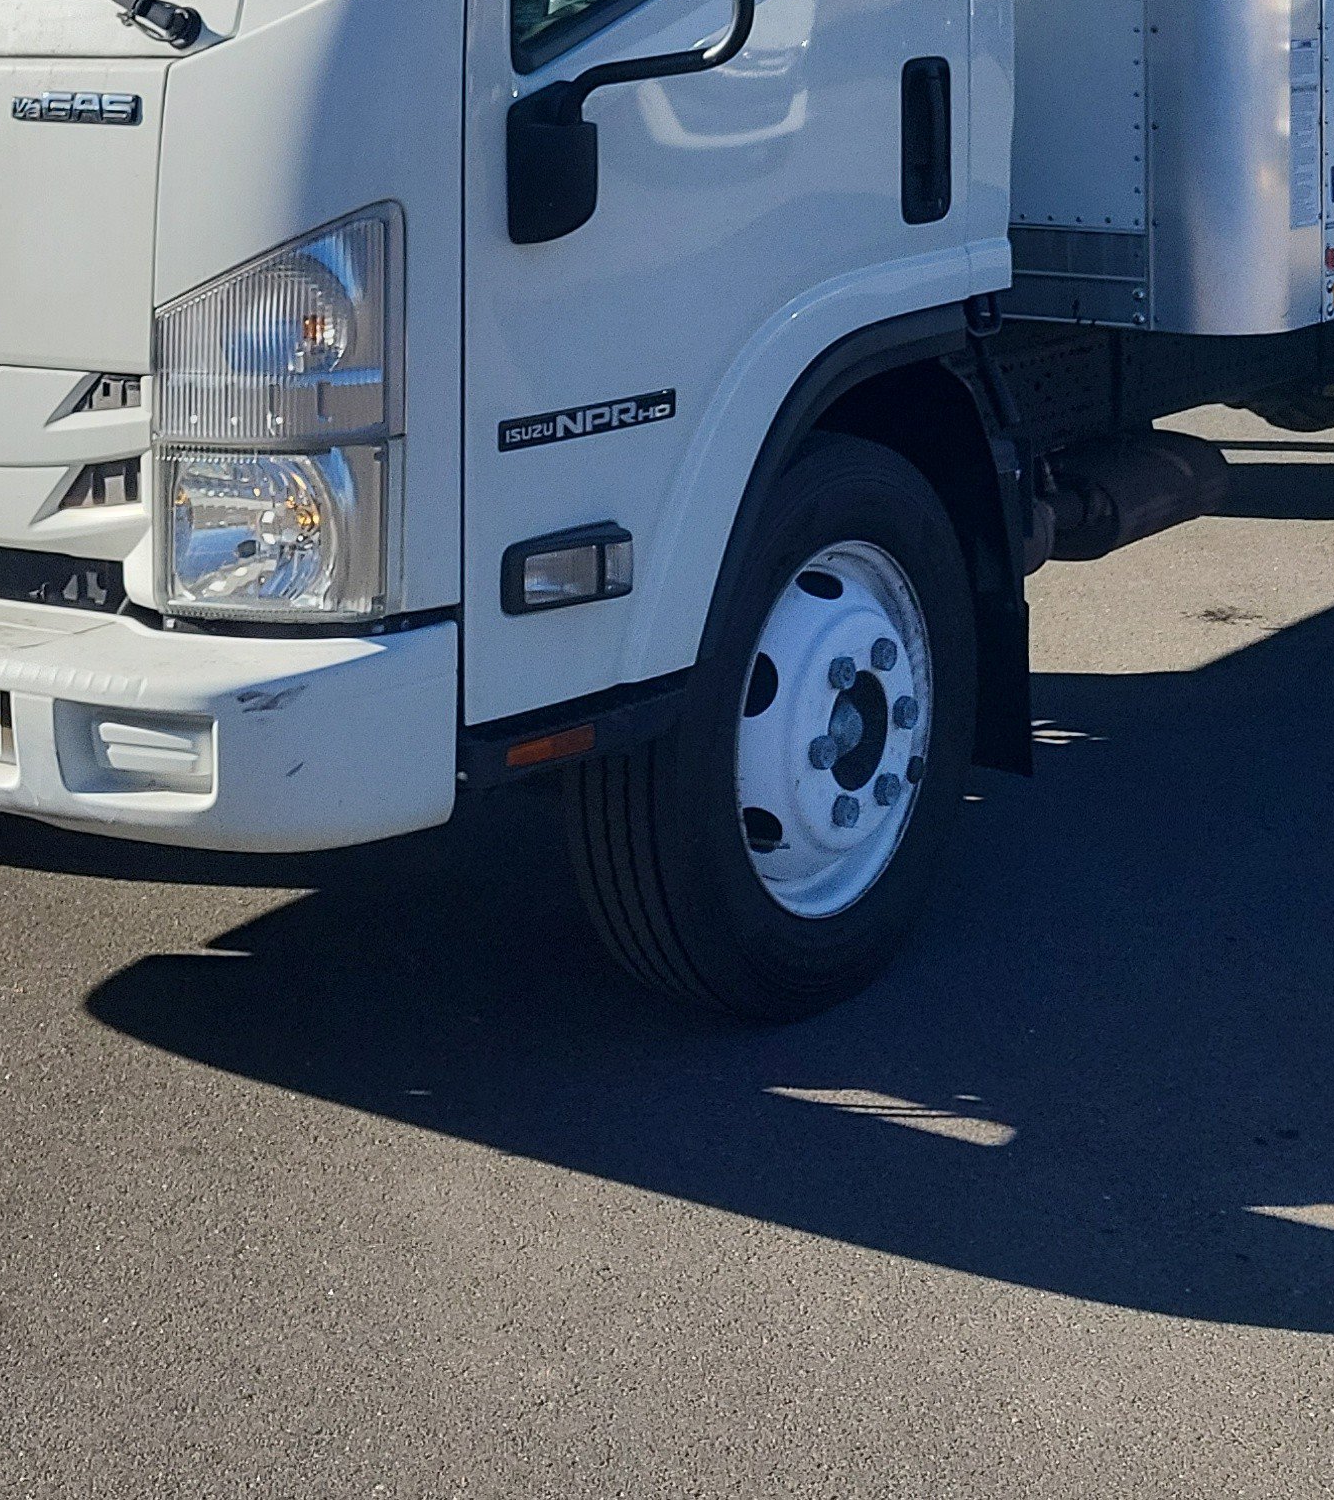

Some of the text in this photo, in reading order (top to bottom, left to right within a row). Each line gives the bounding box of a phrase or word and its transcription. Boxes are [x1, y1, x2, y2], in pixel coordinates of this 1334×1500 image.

[41, 91, 136, 124] GAS
[505, 422, 553, 443] ISUZU
[556, 401, 637, 438] NPR
